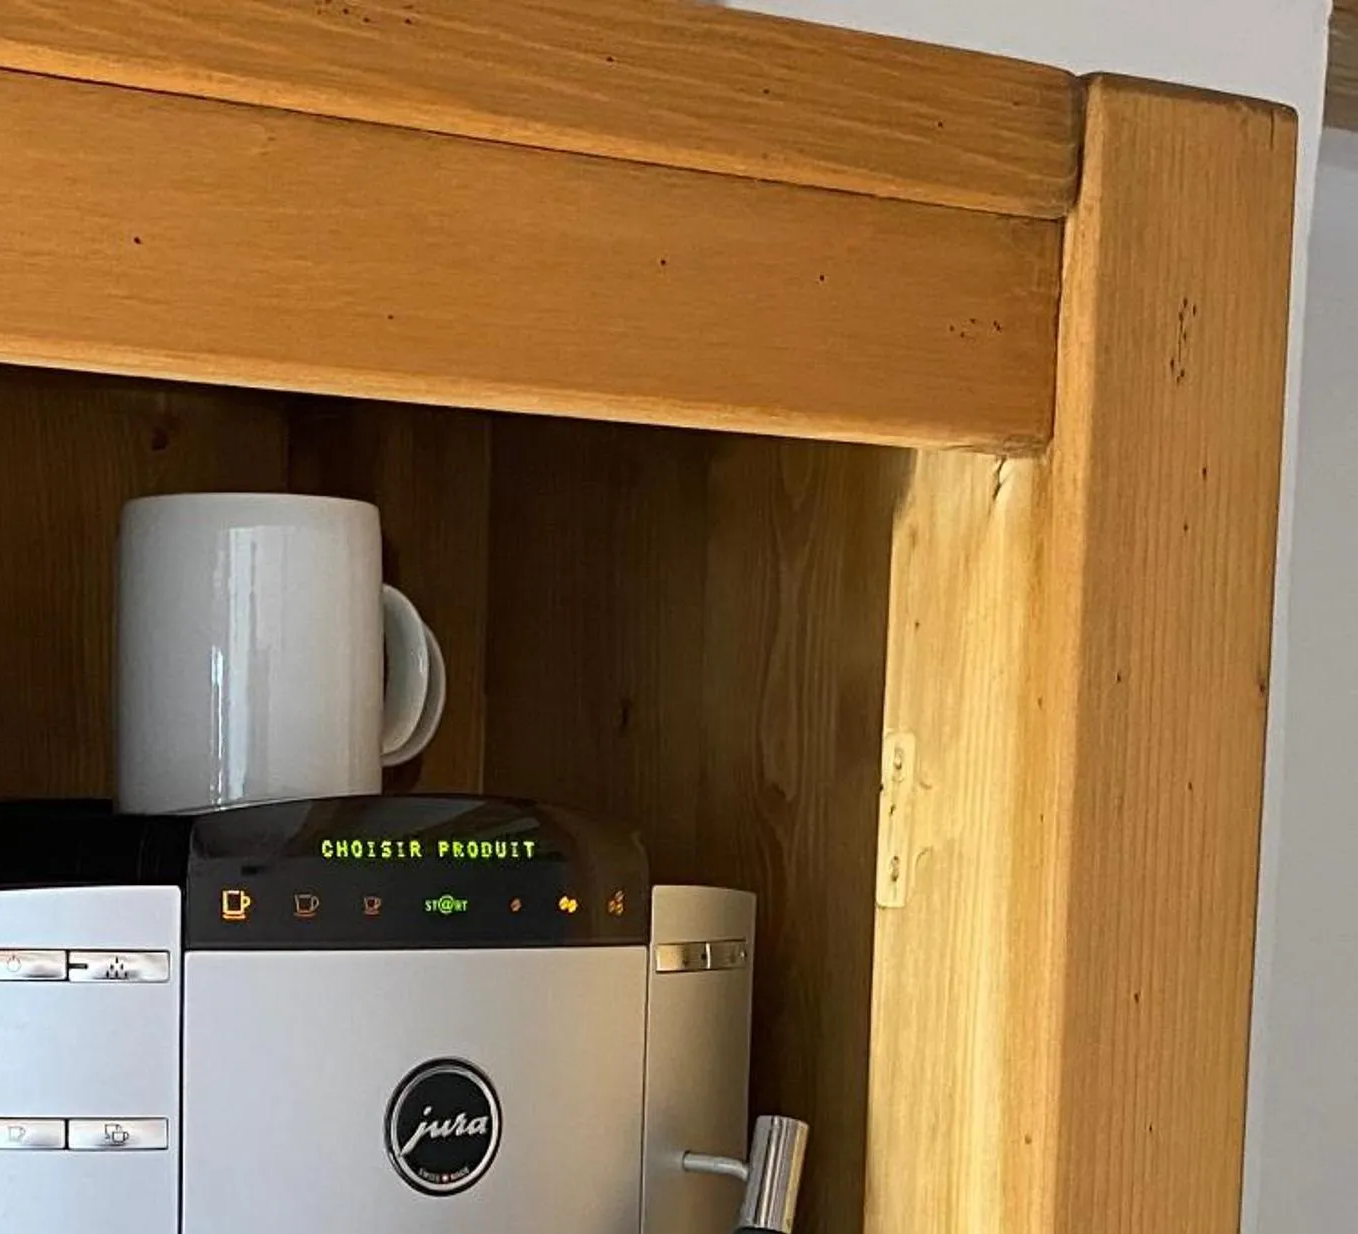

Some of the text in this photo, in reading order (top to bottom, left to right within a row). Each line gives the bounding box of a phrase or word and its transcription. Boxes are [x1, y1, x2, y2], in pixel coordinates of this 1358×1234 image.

[321, 839, 536, 859] CHOISIR PRODUIT
[400, 1105, 490, 1157] jura
